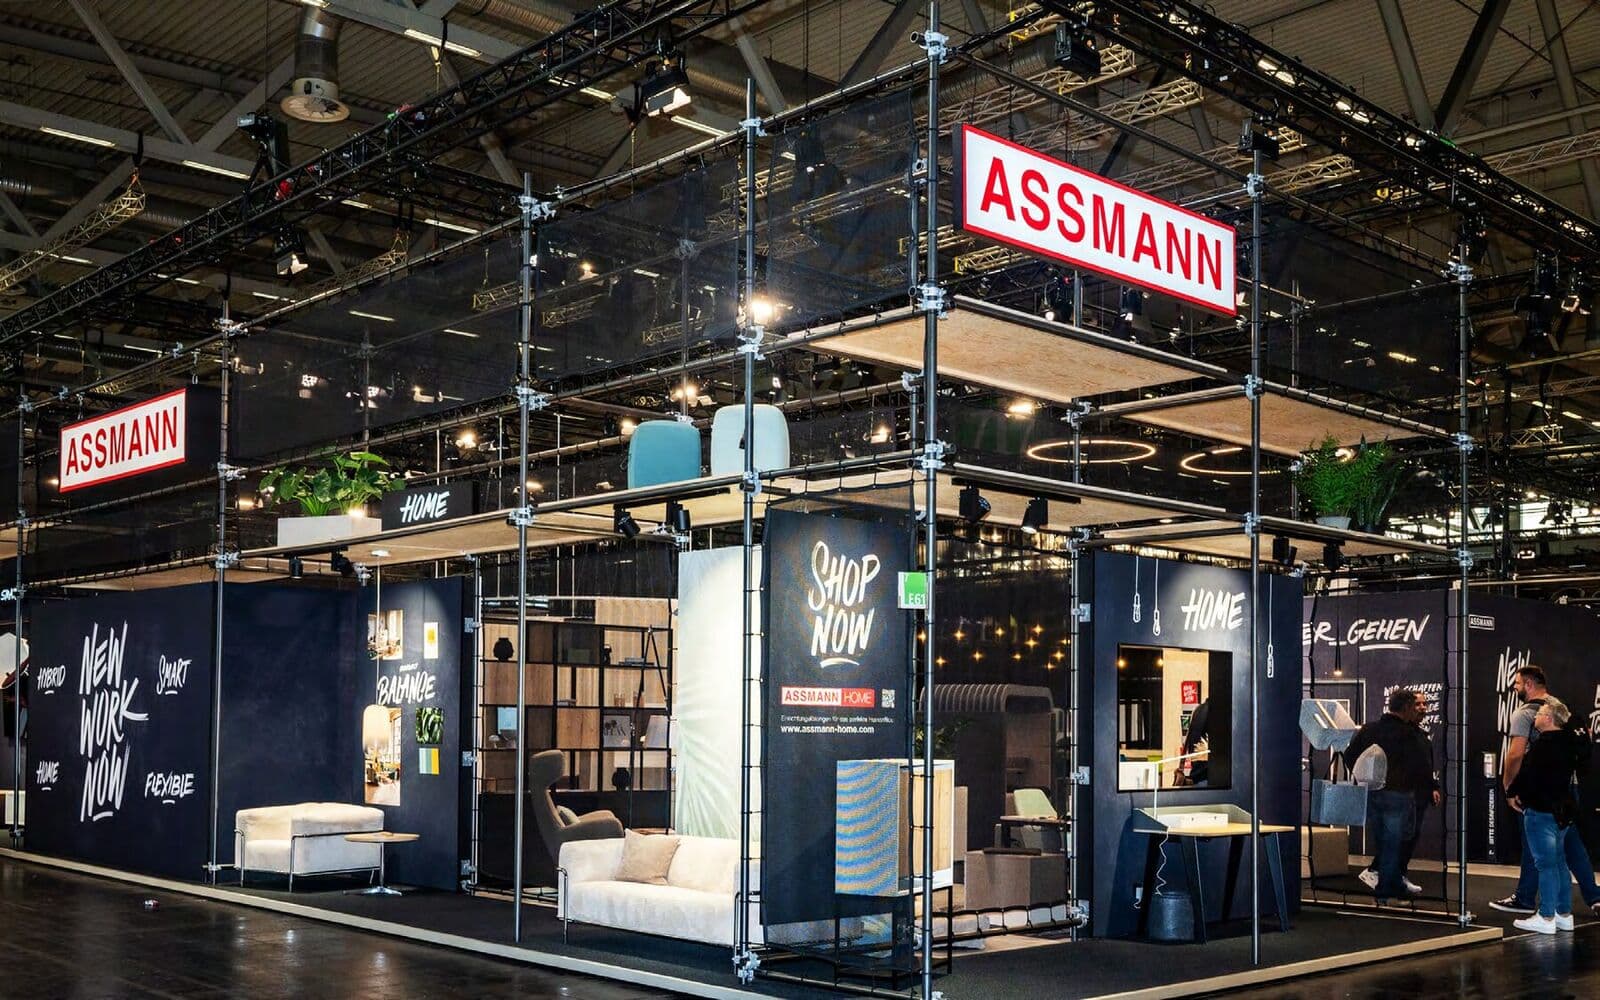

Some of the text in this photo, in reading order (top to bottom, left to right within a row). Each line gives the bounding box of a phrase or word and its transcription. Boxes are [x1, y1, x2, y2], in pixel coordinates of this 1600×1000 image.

[980, 156, 1222, 291] ASSMANN
[66, 406, 178, 476] ASSMANN
[400, 491, 450, 523] HOME
[808, 540, 881, 611] SHOP
[1181, 588, 1247, 632] HOME
[1347, 614, 1430, 645] GEHEN
[811, 605, 875, 657] NOW
[37, 665, 66, 690] HYBRID
[79, 620, 128, 695] NEW
[156, 655, 192, 695] SMART
[377, 671, 436, 705] BALANCE
[784, 690, 872, 704] ASSMANN HOME
[80, 678, 149, 758] WORK
[780, 725, 875, 734] www.assmann-home.com
[36, 761, 60, 784] HOME
[80, 741, 131, 822] NOW
[144, 771, 196, 798] FLEXIBLE
